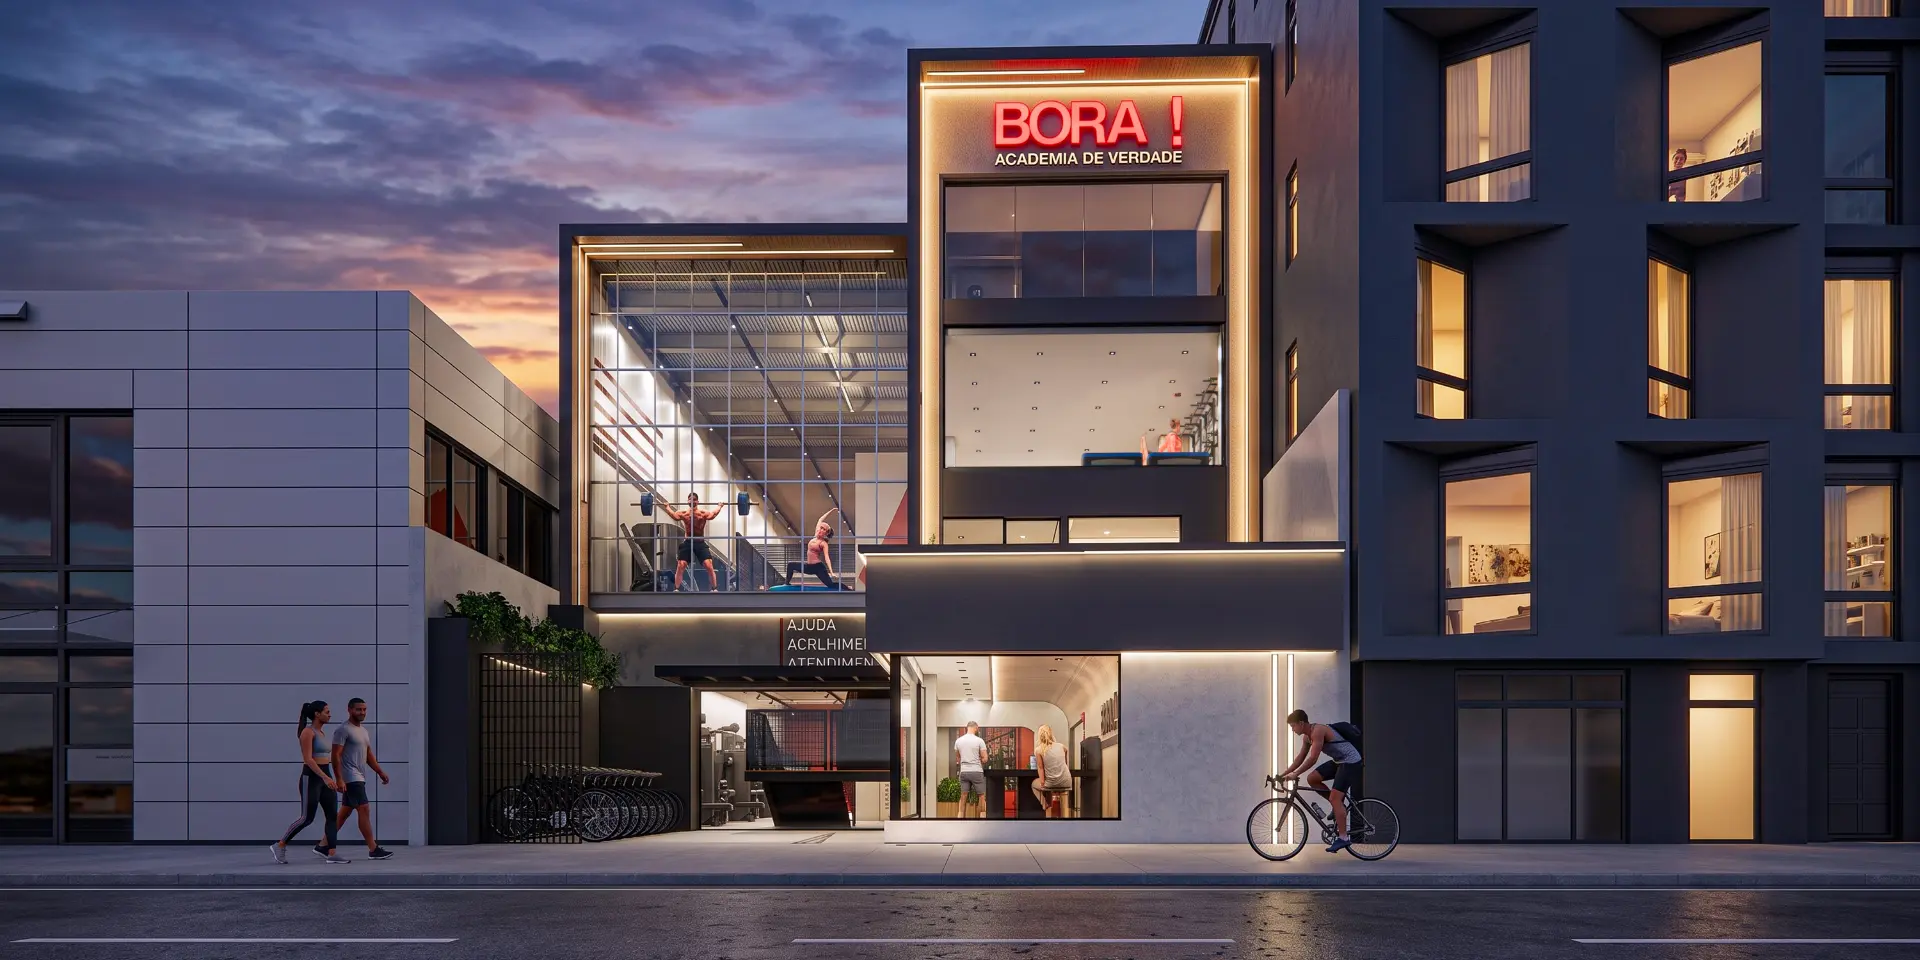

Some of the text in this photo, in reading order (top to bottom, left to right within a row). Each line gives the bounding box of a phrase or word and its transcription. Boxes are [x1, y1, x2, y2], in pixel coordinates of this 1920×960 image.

[994, 96, 1183, 149] BORA !
[995, 151, 1183, 166] ACADEMIA DE VERDADE
[787, 618, 837, 631] AJUDA
